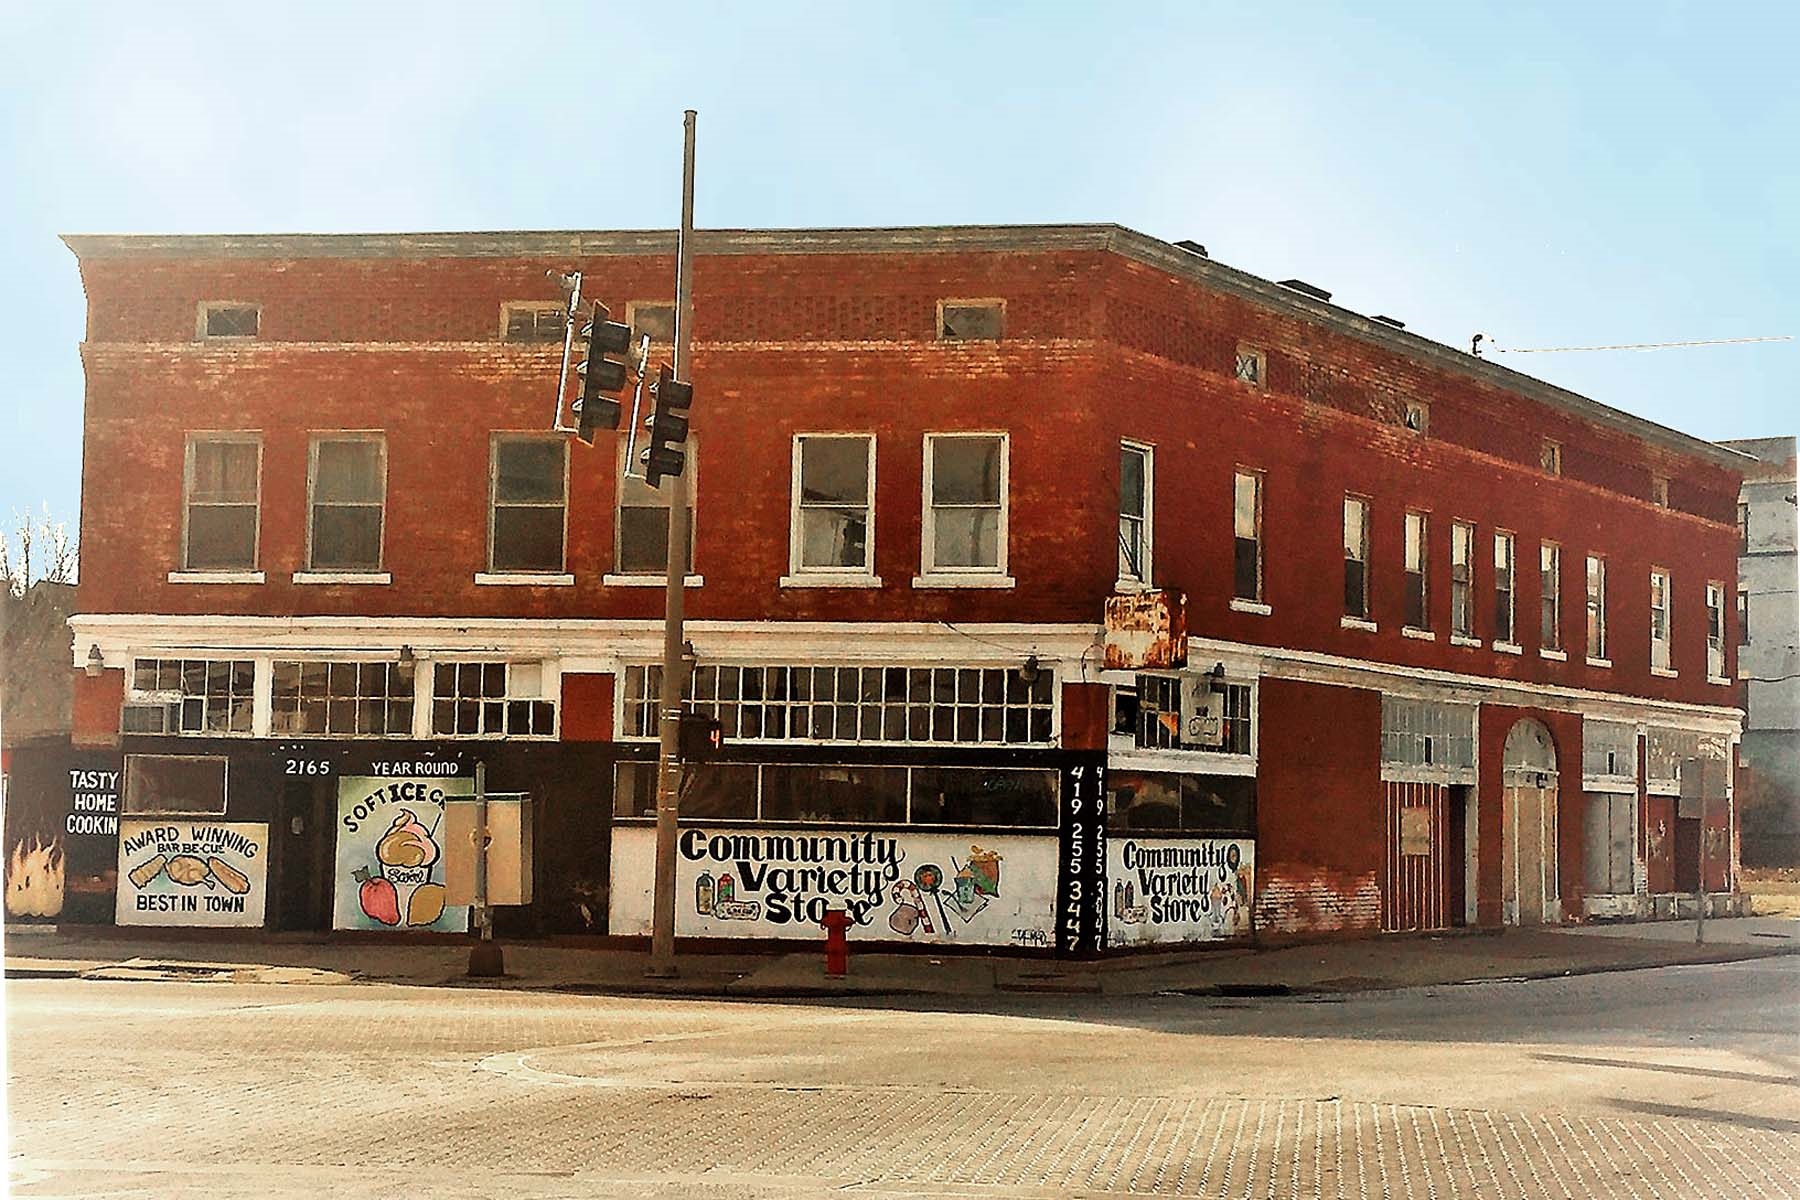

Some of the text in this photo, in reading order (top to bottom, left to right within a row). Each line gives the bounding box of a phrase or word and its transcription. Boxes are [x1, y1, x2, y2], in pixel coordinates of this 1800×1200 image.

[69, 770, 119, 790] TASTY
[285, 759, 331, 776] 2165
[371, 761, 459, 776] YEAR ROUND
[74, 793, 118, 812] HOME
[343, 787, 387, 833] SOFT
[387, 781, 428, 803] ICE
[66, 814, 118, 835] COOKIN
[123, 826, 259, 859] AWARD WINNING
[679, 828, 907, 882] Community
[1123, 839, 1228, 883] Community
[734, 860, 889, 907] Variety
[1137, 868, 1211, 913] Variety
[136, 894, 245, 913] BEST IN TOWN
[1149, 896, 1203, 925] Store
